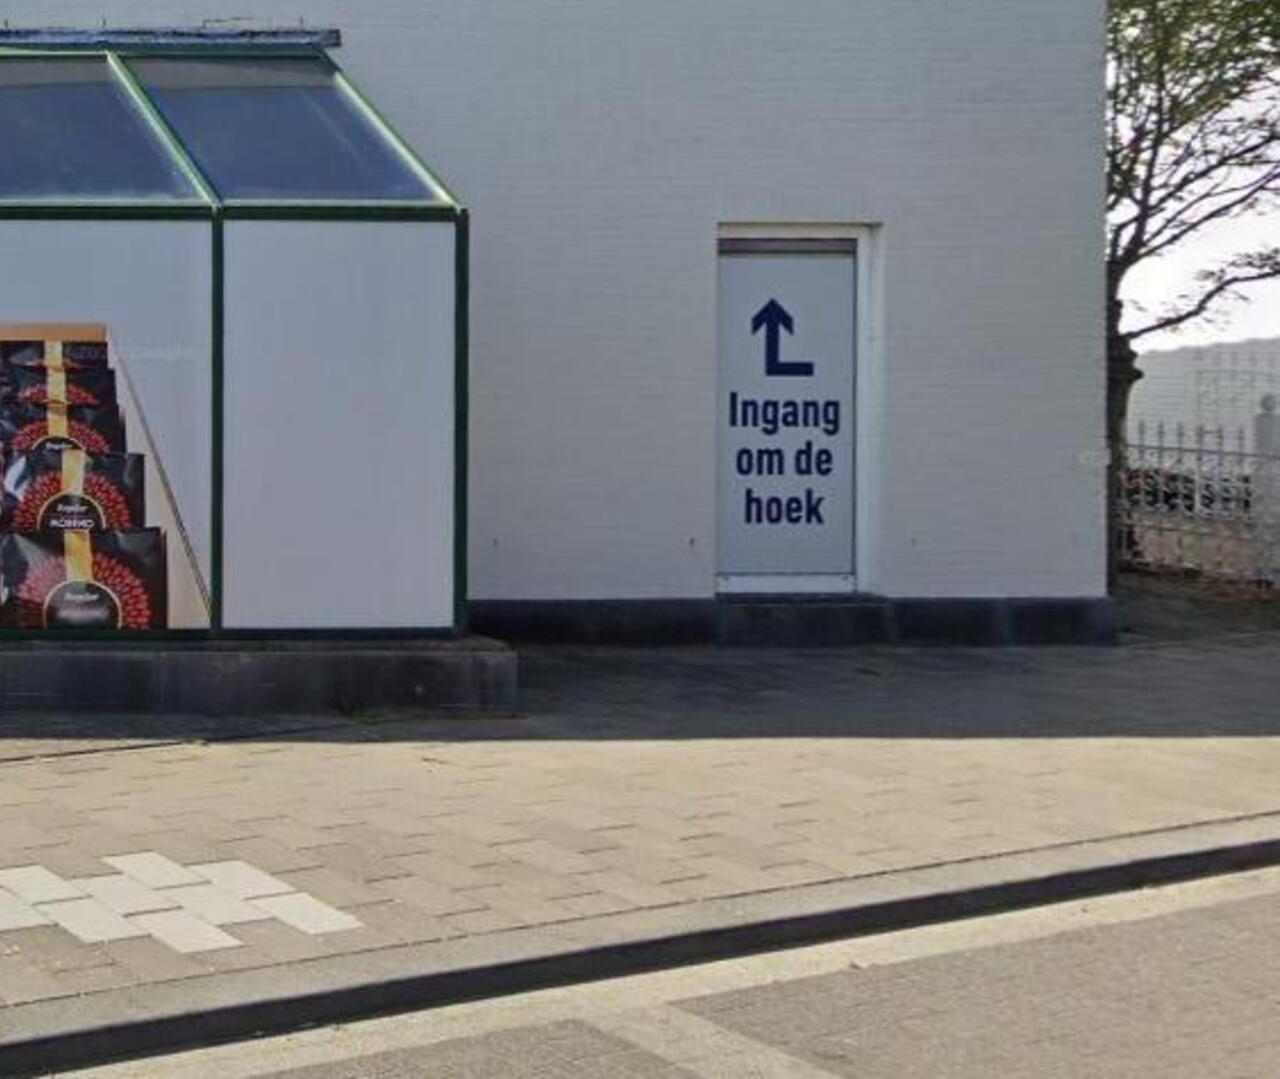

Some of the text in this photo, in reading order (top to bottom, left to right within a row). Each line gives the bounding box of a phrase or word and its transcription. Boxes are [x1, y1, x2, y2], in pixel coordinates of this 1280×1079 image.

[729, 392, 840, 436] Ingang
[736, 440, 833, 476] om de
[744, 488, 825, 524] hoek
